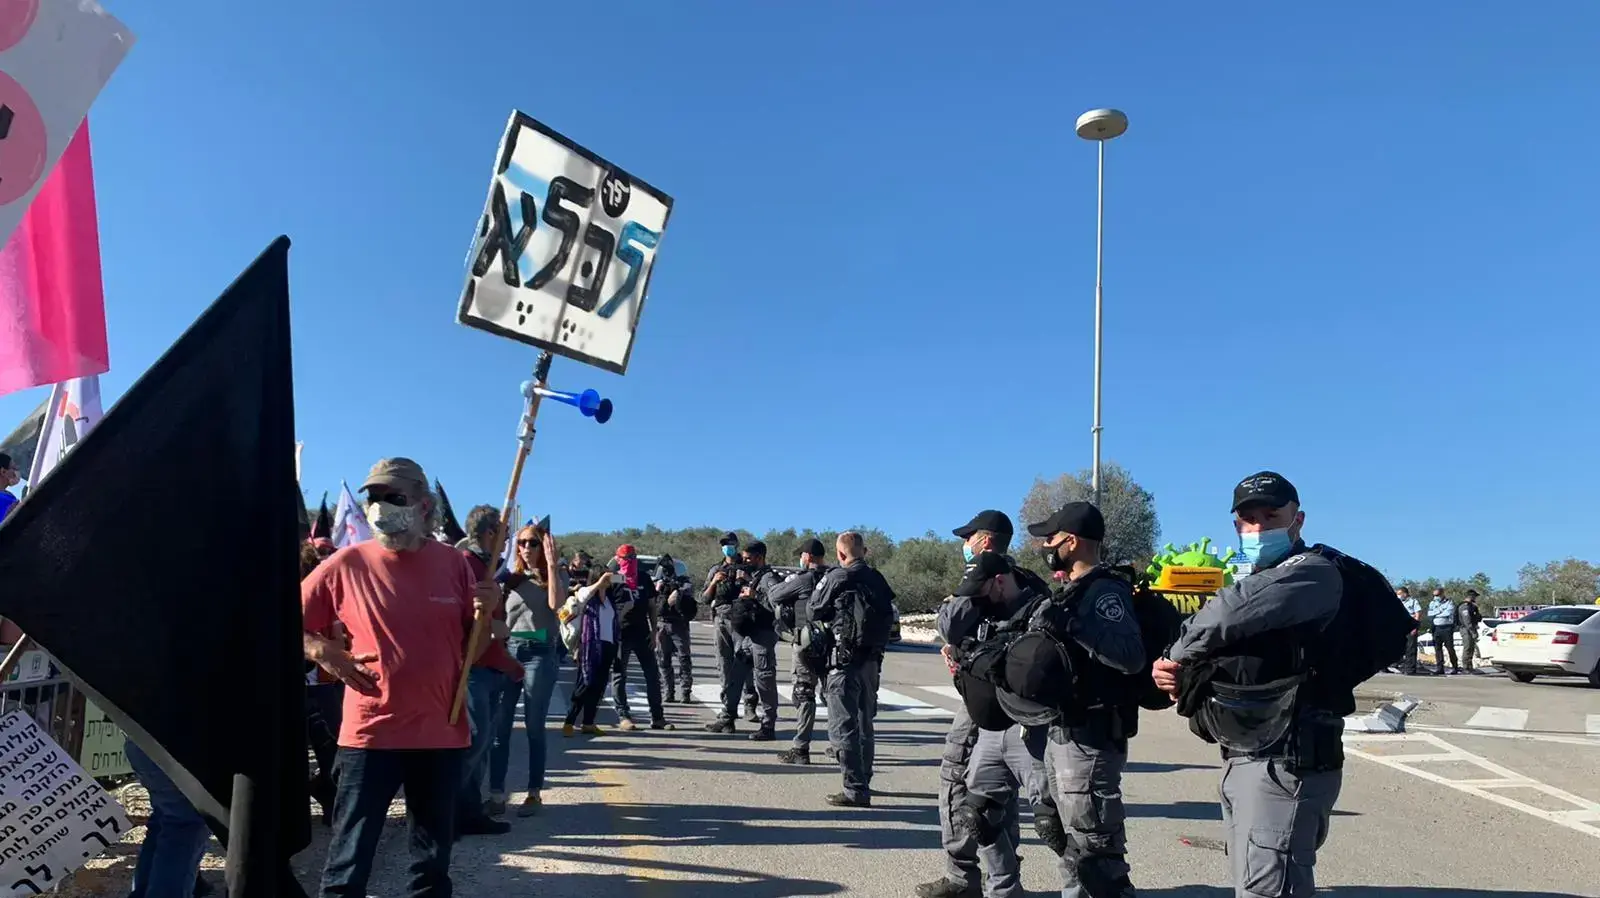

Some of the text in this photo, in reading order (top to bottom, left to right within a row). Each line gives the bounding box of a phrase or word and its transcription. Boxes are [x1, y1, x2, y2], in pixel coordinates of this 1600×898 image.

[12, 750, 58, 783] שבכל
[21, 762, 70, 800] הזקנה
[42, 774, 82, 807] מתים
[54, 783, 101, 820] בקולם
[18, 804, 42, 825] פה
[77, 796, 108, 821] ואת
[30, 816, 55, 836] הם
